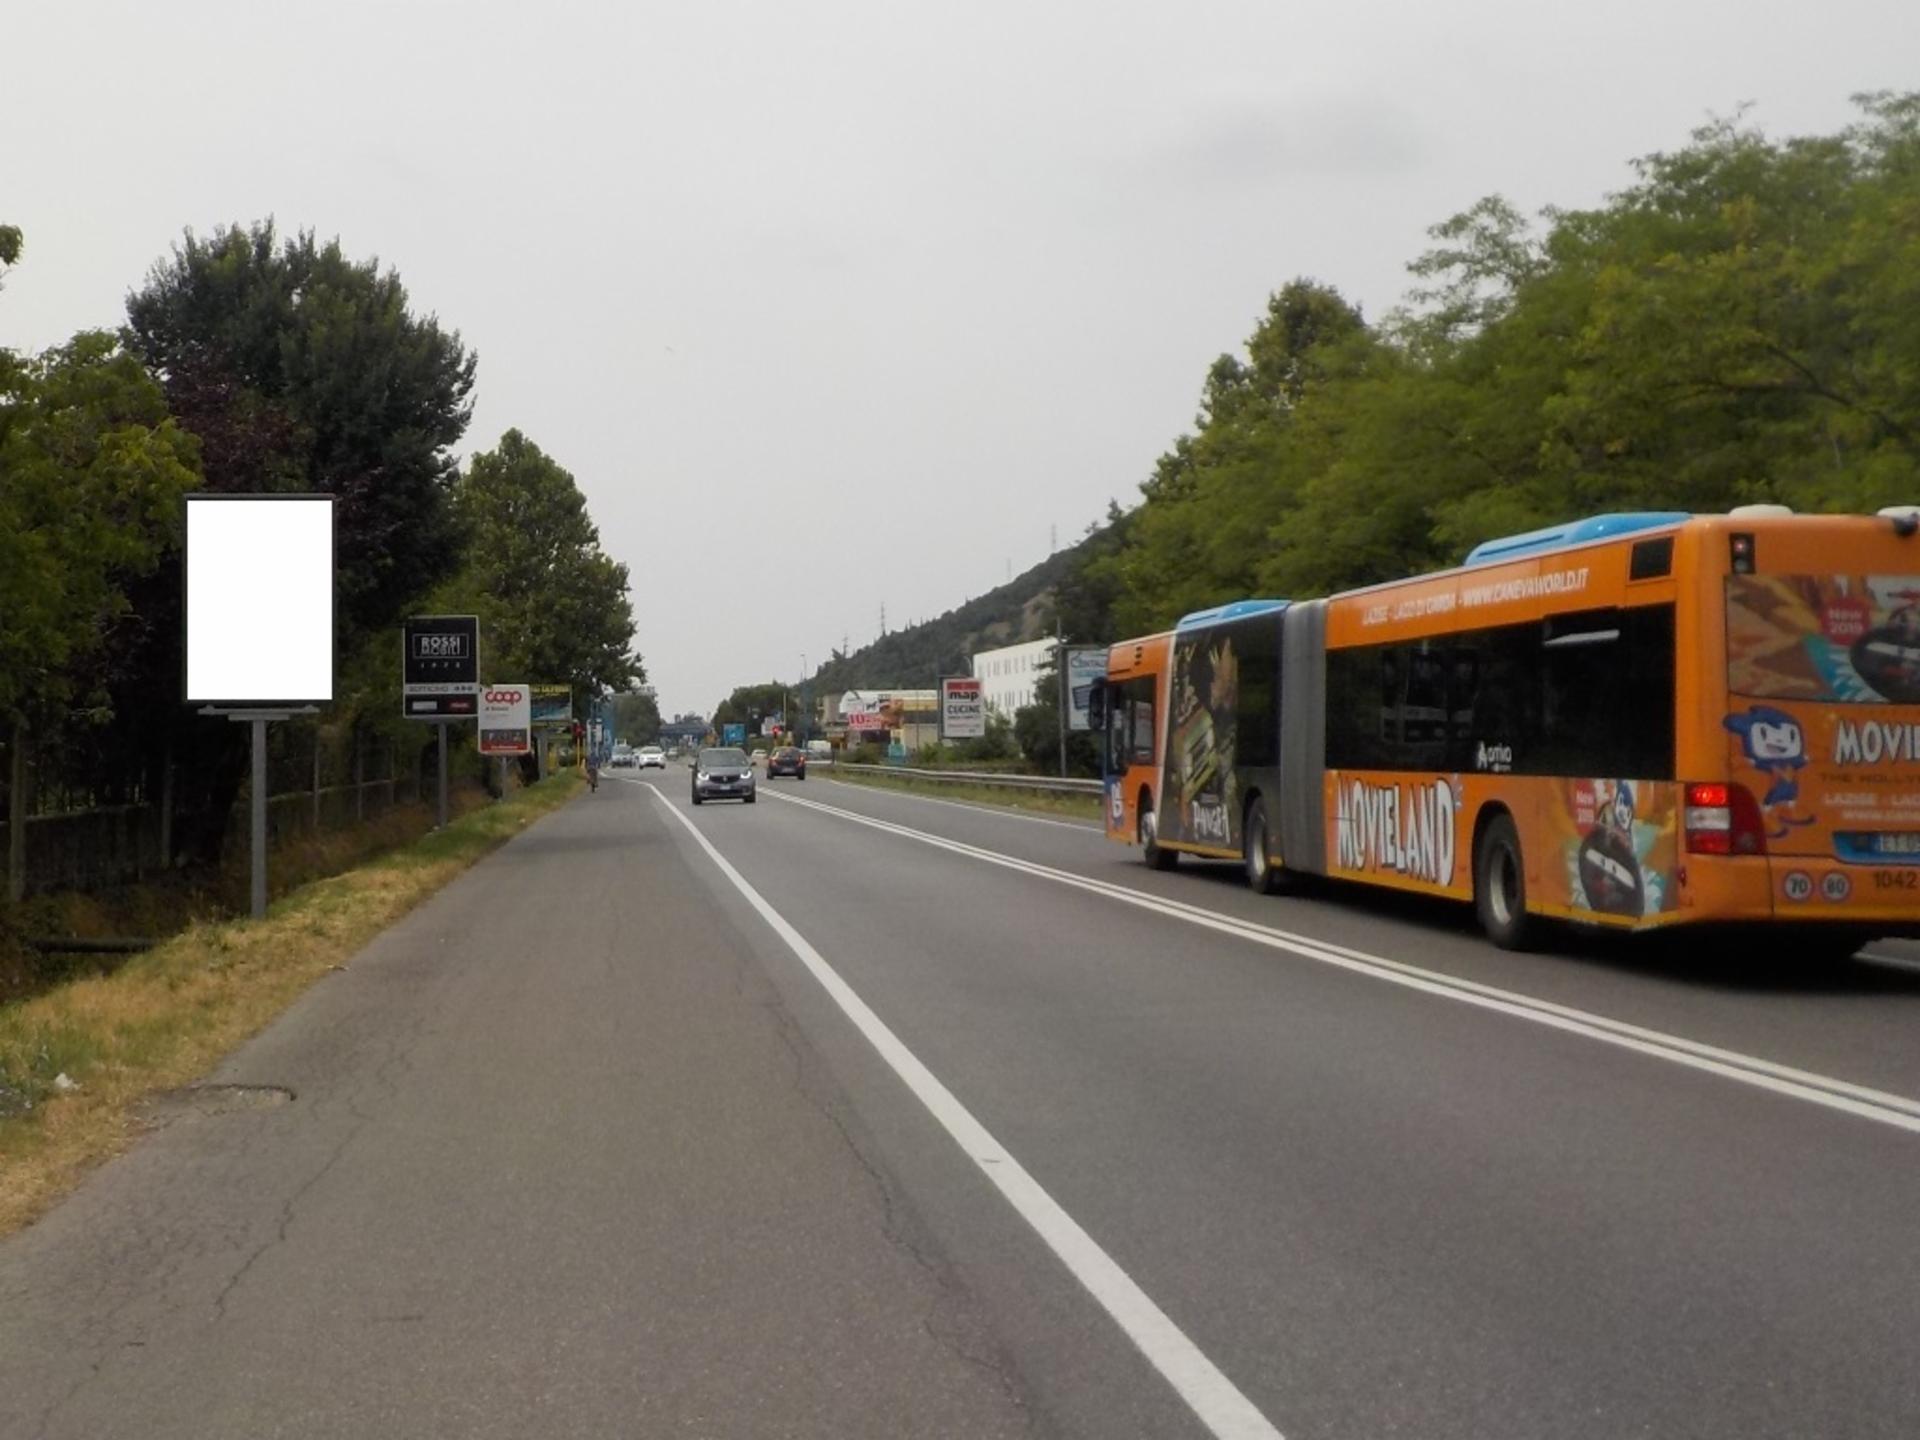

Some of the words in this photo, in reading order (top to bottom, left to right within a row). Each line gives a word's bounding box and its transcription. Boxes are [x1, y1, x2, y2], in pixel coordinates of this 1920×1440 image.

[421, 637, 461, 648] ROSSI
[485, 689, 522, 705] coop
[1337, 777, 1454, 886] MOVIELAND
[1789, 877, 1809, 894] 70
